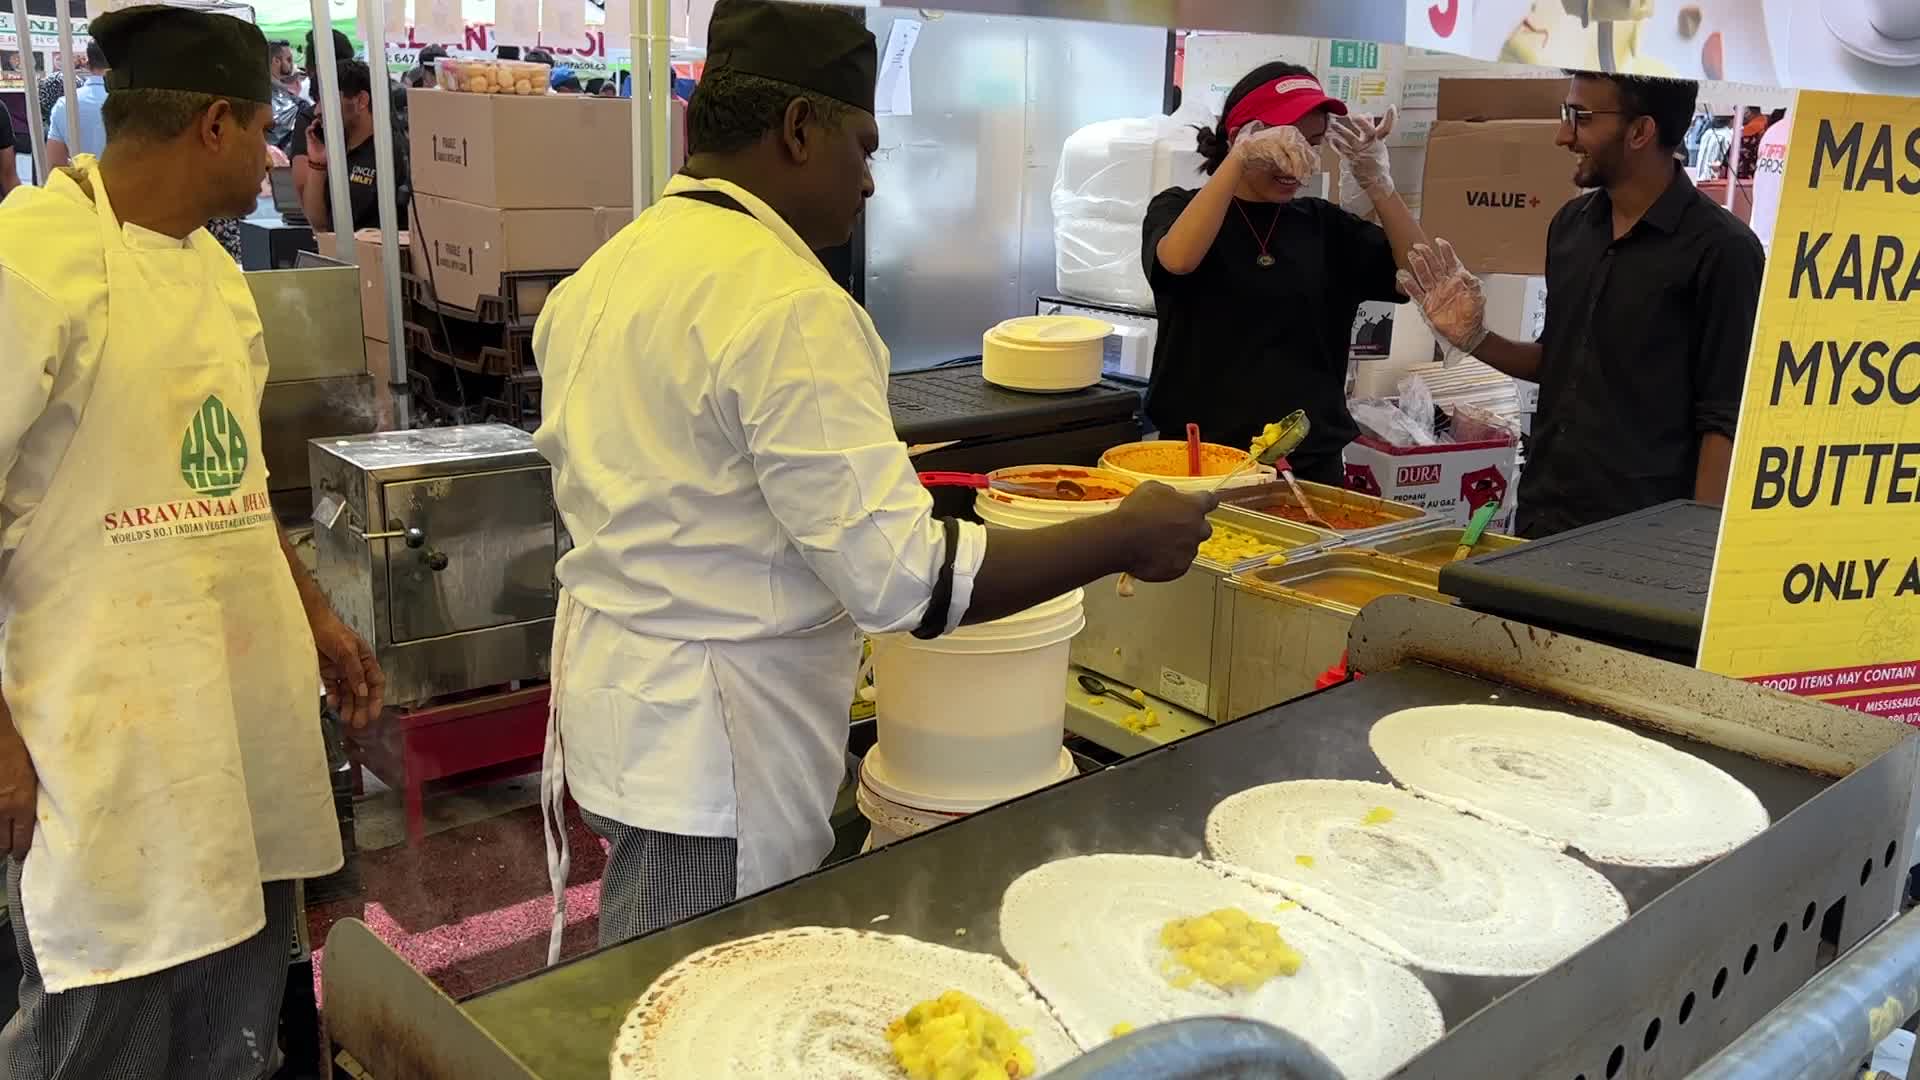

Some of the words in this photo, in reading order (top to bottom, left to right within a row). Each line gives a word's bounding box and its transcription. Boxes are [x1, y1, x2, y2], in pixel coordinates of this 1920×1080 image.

[1398, 466, 1440, 484] DURA
[1751, 443, 1920, 509] BUTTE
[104, 498, 239, 531] SARAVANAA
[111, 529, 151, 545] WORLD'S
[175, 522, 204, 535] INDIAN
[1782, 558, 1890, 605] ONLY
[1800, 674, 1833, 689] ITEMS
[1836, 671, 1862, 685] MAY
[1863, 666, 1916, 683] CONTAIN
